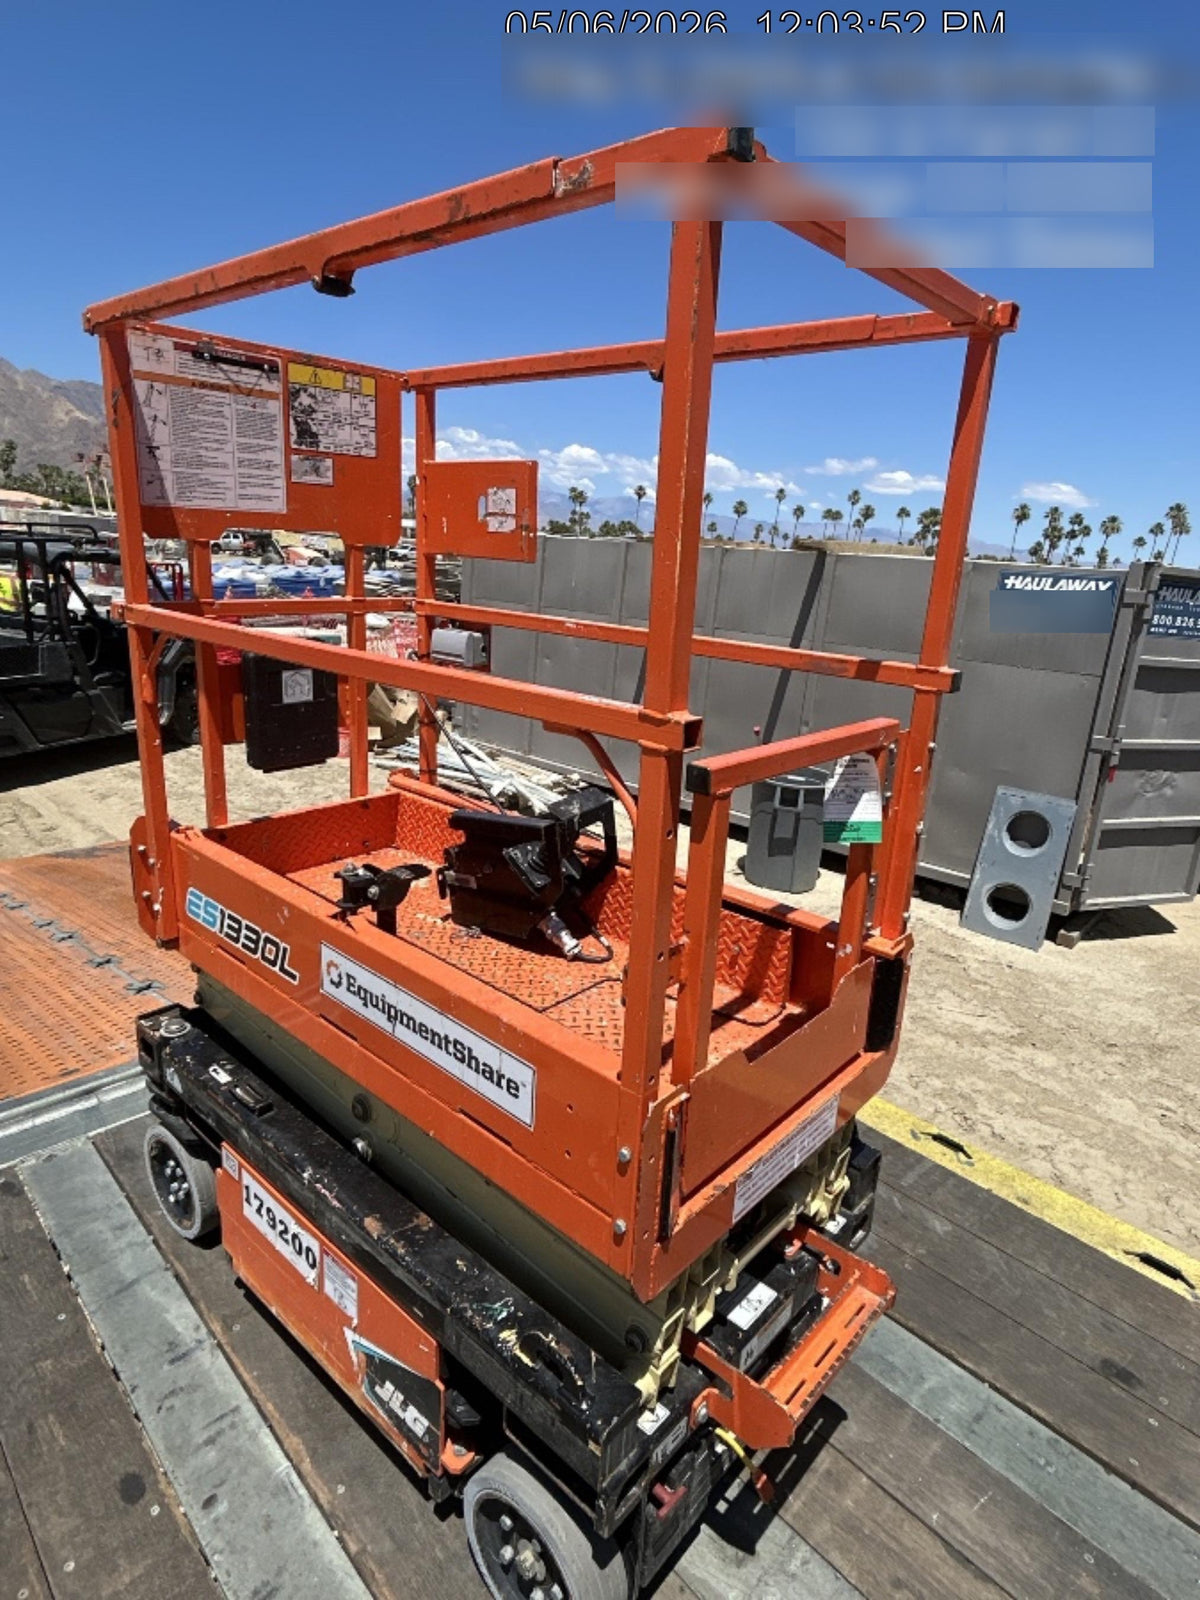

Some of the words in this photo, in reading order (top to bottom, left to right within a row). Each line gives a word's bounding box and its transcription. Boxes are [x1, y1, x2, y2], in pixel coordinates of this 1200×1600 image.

[1004, 575, 1113, 591] HAULAWAY
[187, 889, 298, 983] ES1330L
[244, 1183, 318, 1271] 179200
[374, 1380, 430, 1439] JLG
